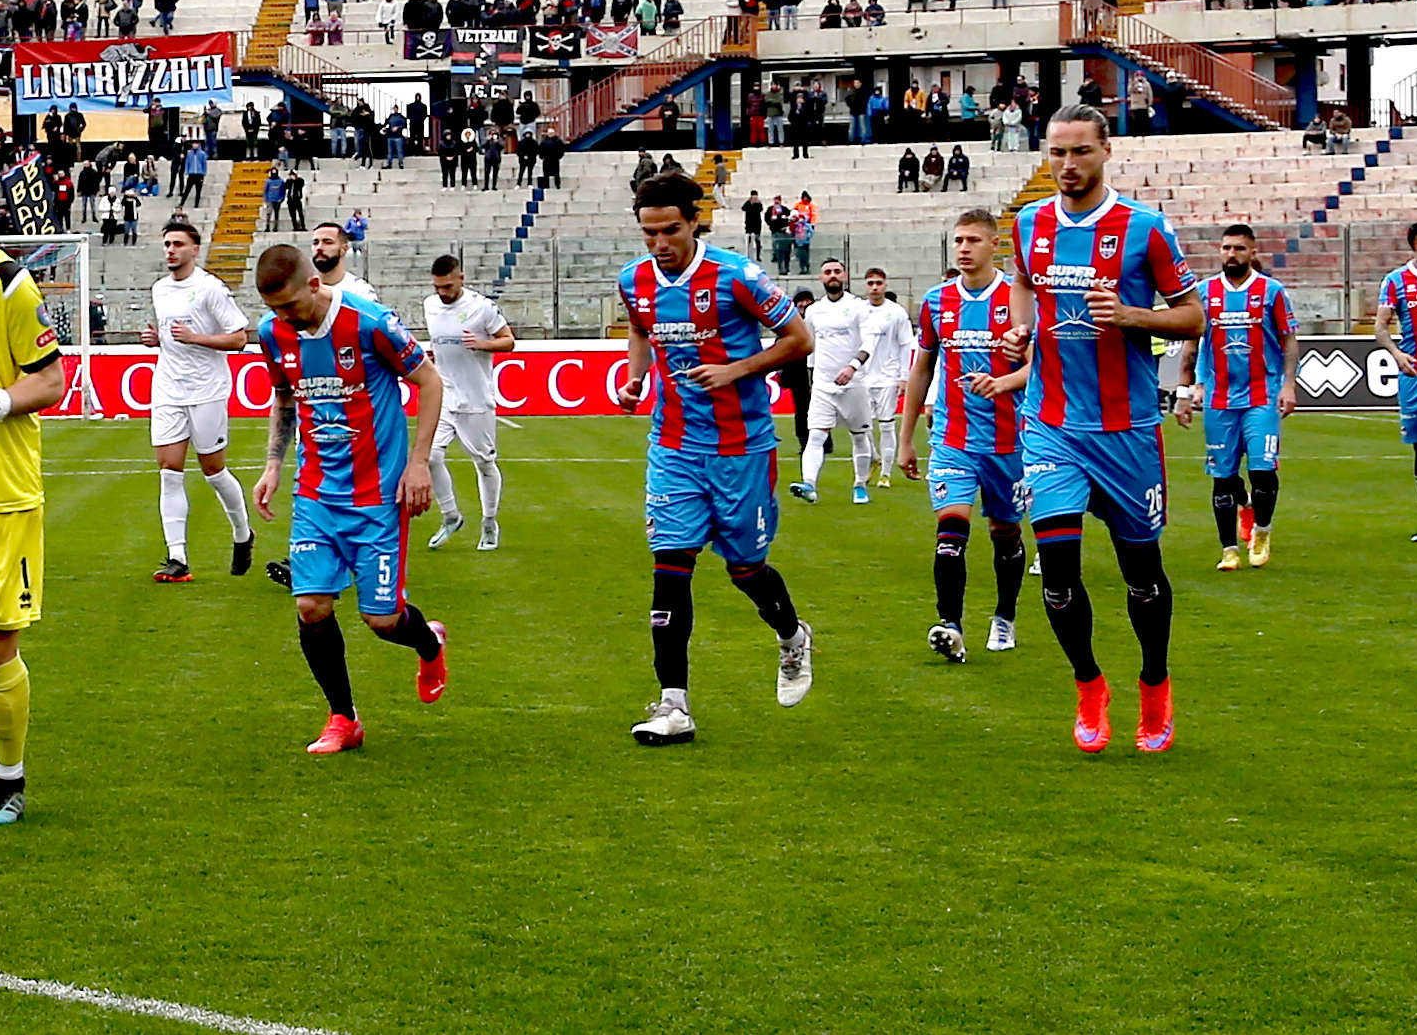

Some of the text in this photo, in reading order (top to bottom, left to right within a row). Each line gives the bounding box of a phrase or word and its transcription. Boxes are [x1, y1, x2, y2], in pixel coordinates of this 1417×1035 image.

[456, 29, 517, 43] VETERANI
[1046, 264, 1097, 278] SUPER
[652, 322, 696, 333] SUPER
[1265, 435, 1278, 452] 18
[1145, 484, 1162, 515] 26
[20, 557, 29, 589] 1
[378, 555, 391, 585] 5
